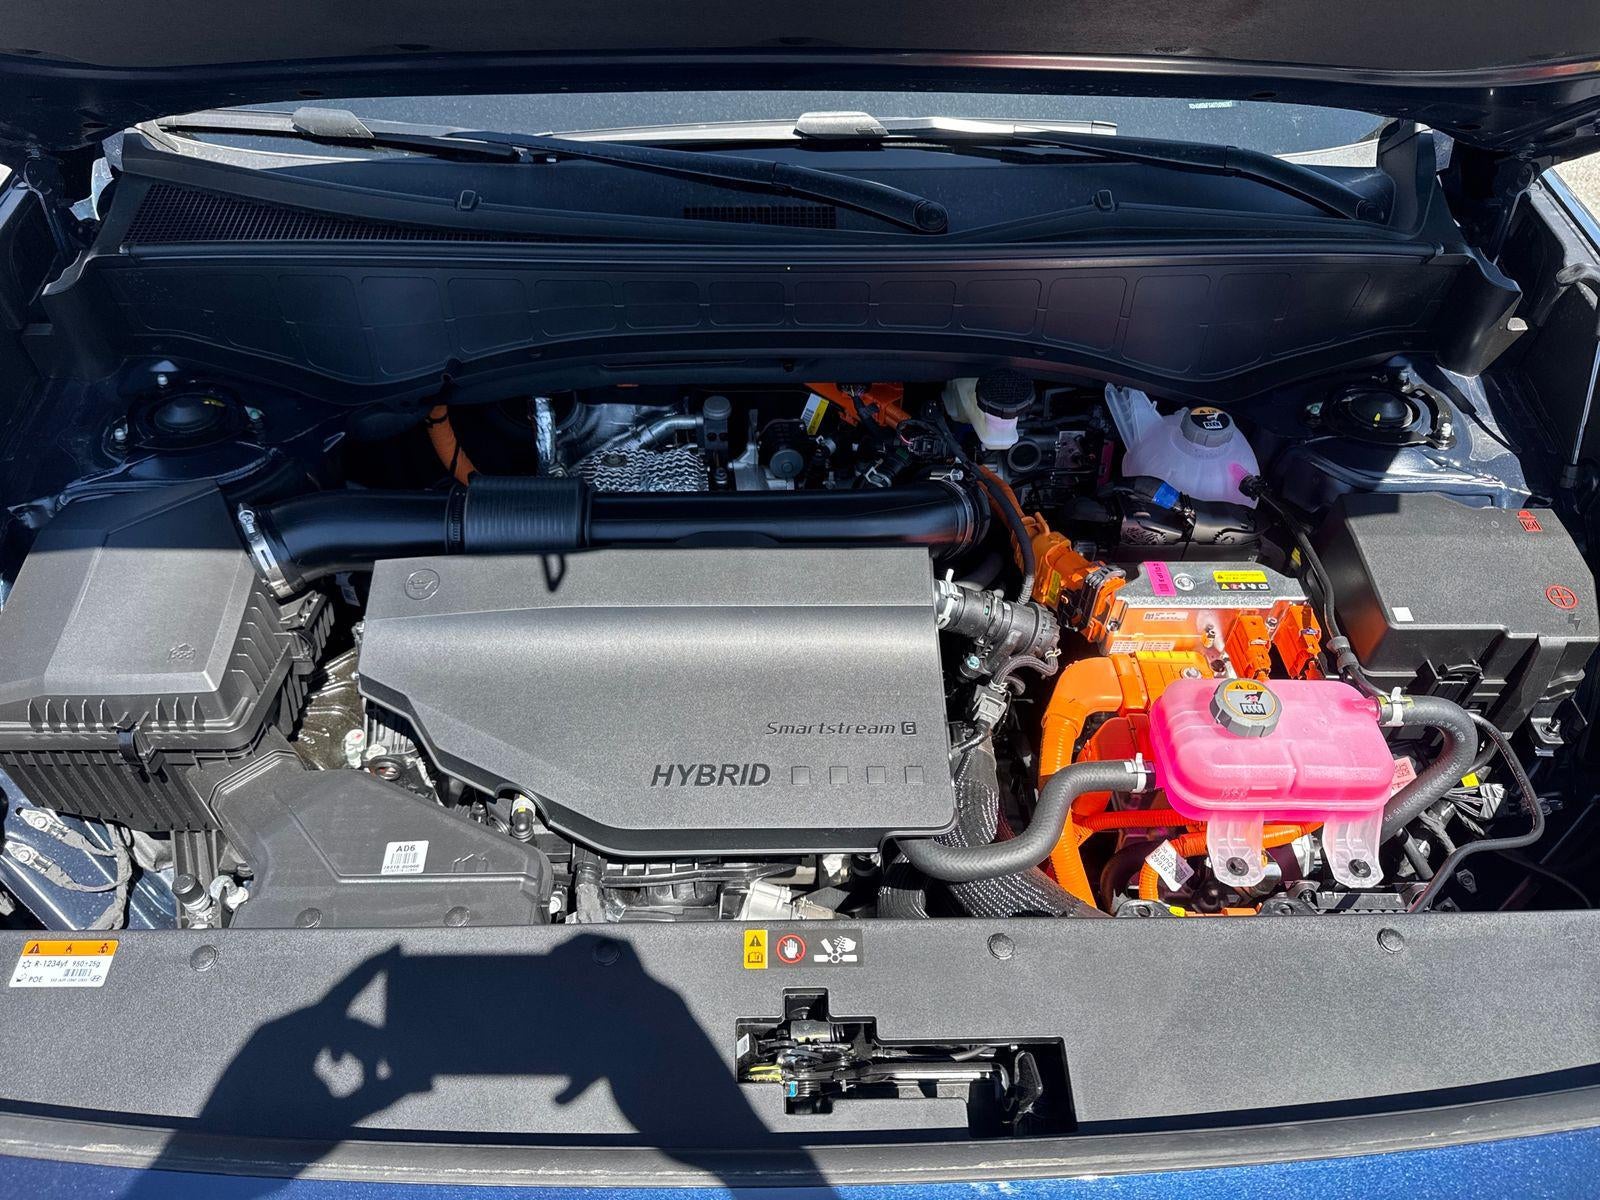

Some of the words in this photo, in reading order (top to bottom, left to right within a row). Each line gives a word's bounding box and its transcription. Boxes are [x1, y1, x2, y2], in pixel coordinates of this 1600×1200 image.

[765, 721, 896, 735] Smartstream
[650, 763, 771, 787] HYBRID
[396, 844, 416, 852] AD6
